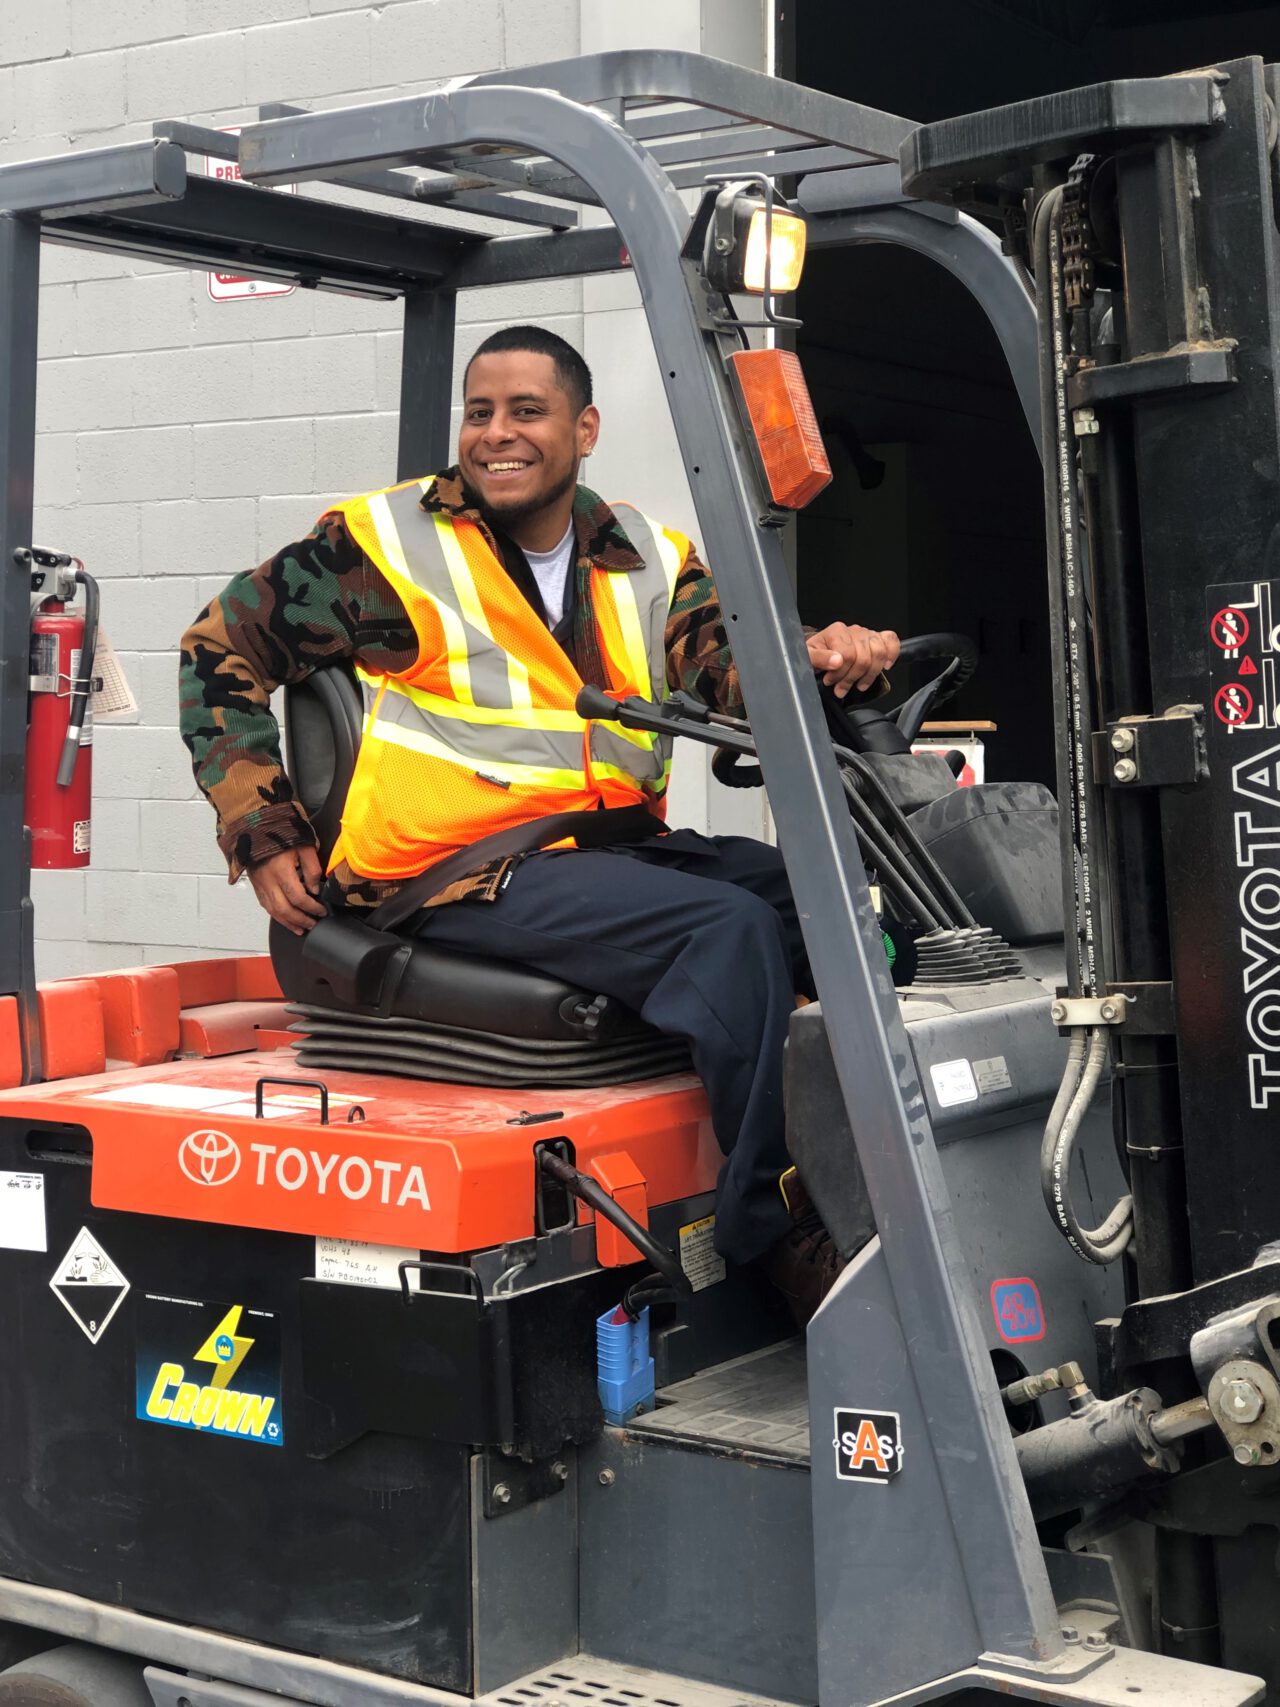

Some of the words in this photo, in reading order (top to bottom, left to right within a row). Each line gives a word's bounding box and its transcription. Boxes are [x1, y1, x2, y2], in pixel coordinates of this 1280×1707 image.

[1064, 506, 1072, 529] WIRE
[1076, 742, 1084, 762] 4000
[1078, 782, 1085, 797] WP
[1082, 853, 1090, 903] SAE100R16
[1054, 1148, 1064, 1162] PSI
[250, 1143, 431, 1211] TOYOTA
[1054, 1164, 1061, 1178] WP
[1056, 1204, 1068, 1227] BAR)
[90, 1320, 96, 1332] 8
[146, 1362, 275, 1437] CROWN
